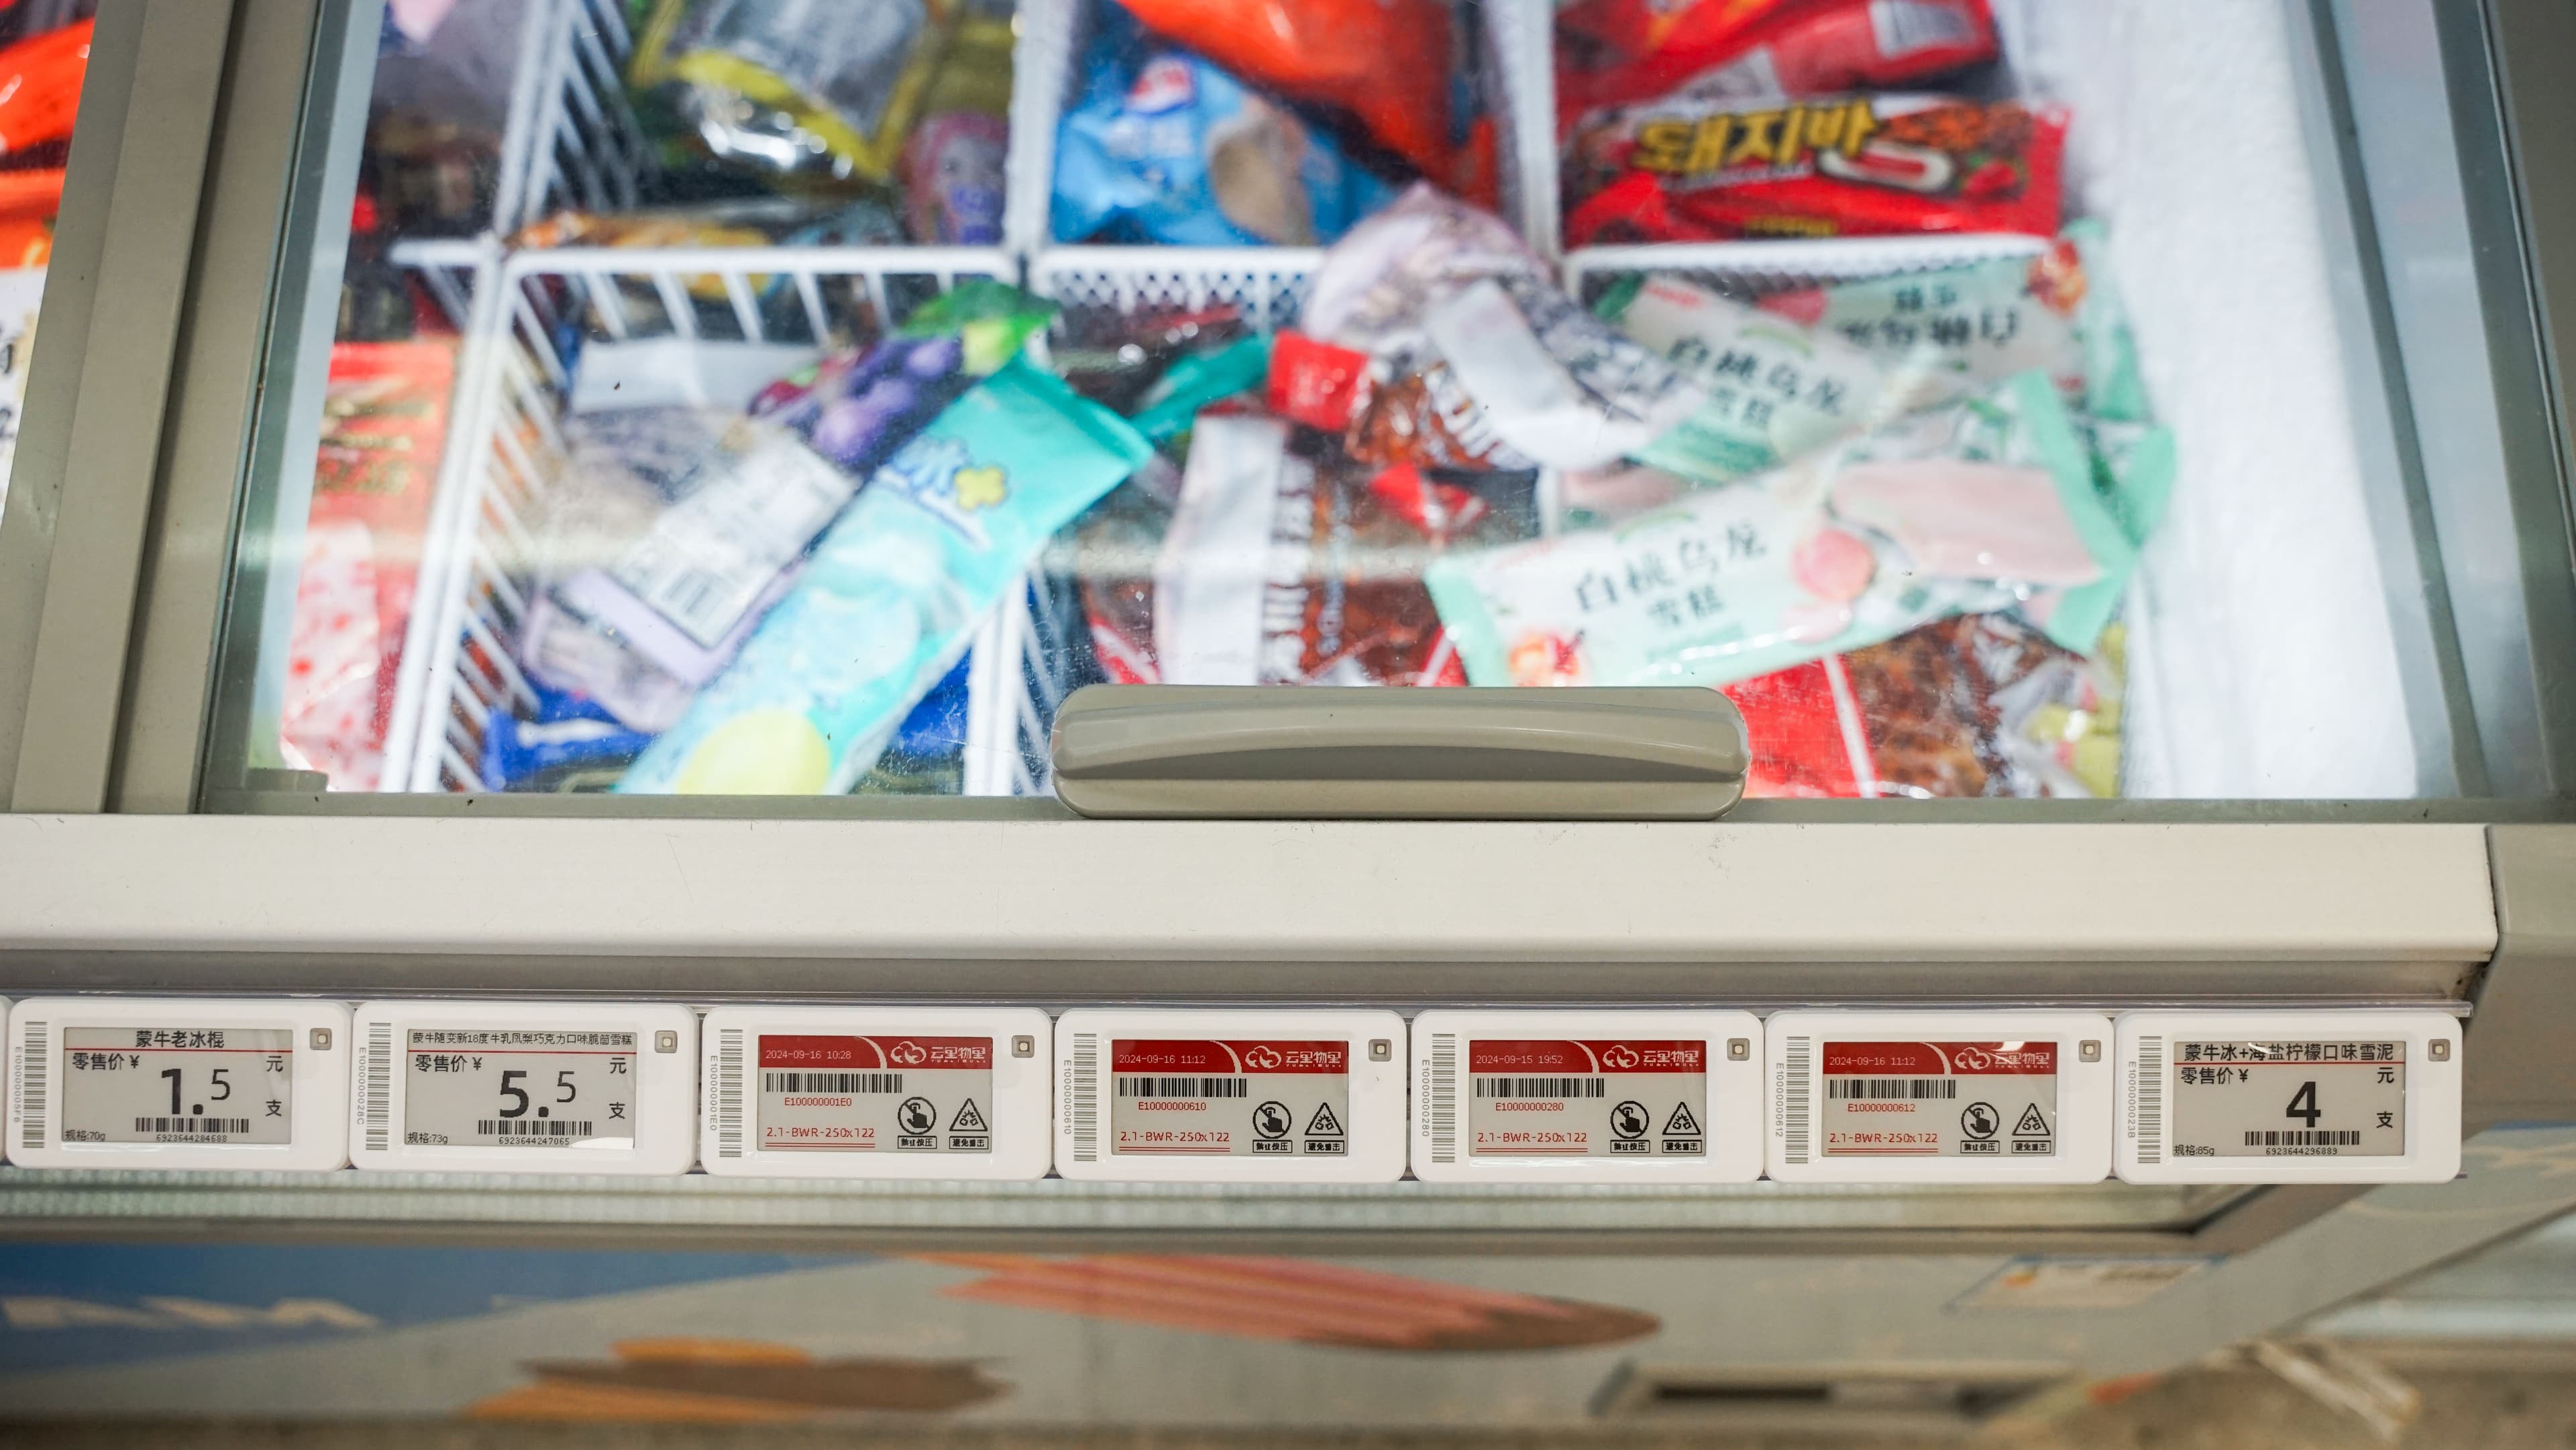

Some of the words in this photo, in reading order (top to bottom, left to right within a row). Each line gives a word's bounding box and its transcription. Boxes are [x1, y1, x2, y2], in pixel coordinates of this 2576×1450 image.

[1630, 97, 1876, 177] 돼지바
[136, 1031, 224, 1048] 蒙牛老冰棍
[765, 1050, 822, 1059] 2024-09-16
[826, 1051, 851, 1059] 10:28
[2184, 1043, 2394, 1061] 蒙牛冰+海盐柠檬口味雪泥
[266, 1055, 283, 1072] 元
[610, 1057, 627, 1074] 元
[1119, 1055, 1175, 1064] 2024-09-16
[1181, 1055, 1205, 1064] 11:12
[1476, 1055, 1533, 1064] 2024-09-15
[1538, 1055, 1563, 1064] 19:52
[1830, 1057, 1885, 1066] 2024-09-16
[1891, 1057, 1915, 1066] 11:12
[2377, 1067, 2394, 1084] 元
[357, 1047, 367, 1125] E1000000028C
[710, 1055, 718, 1131] E100000001E0
[784, 1097, 852, 1106] E100000001E0
[1064, 1059, 1072, 1135] E10000000610
[1422, 1059, 1430, 1137] E10000000280
[1776, 1063, 1784, 1137] E10000000612
[2128, 1061, 2137, 1139] E1000000023B
[266, 1100, 282, 1117] 支
[609, 1102, 625, 1119] 支
[1138, 1102, 1206, 1110] E10000000610
[1495, 1102, 1564, 1111] E10000000280
[1847, 1104, 1915, 1112] E10000000612
[2286, 1081, 2321, 1128] 4
[2376, 1111, 2393, 1129] 支
[156, 1134, 227, 1143] 6923644284688
[408, 1132, 448, 1144] 规格:73g
[767, 1127, 875, 1137] 2.1-BWR-250x122
[1120, 1131, 1229, 1141] 2.1-BWR-250x122
[1478, 1133, 1587, 1142] 2.1-BWR-250x122
[1830, 1133, 1937, 1143] 2.1-BWR-250x122
[499, 1137, 570, 1145] 6923644247065
[2174, 1145, 2214, 1156] 规格:85g
